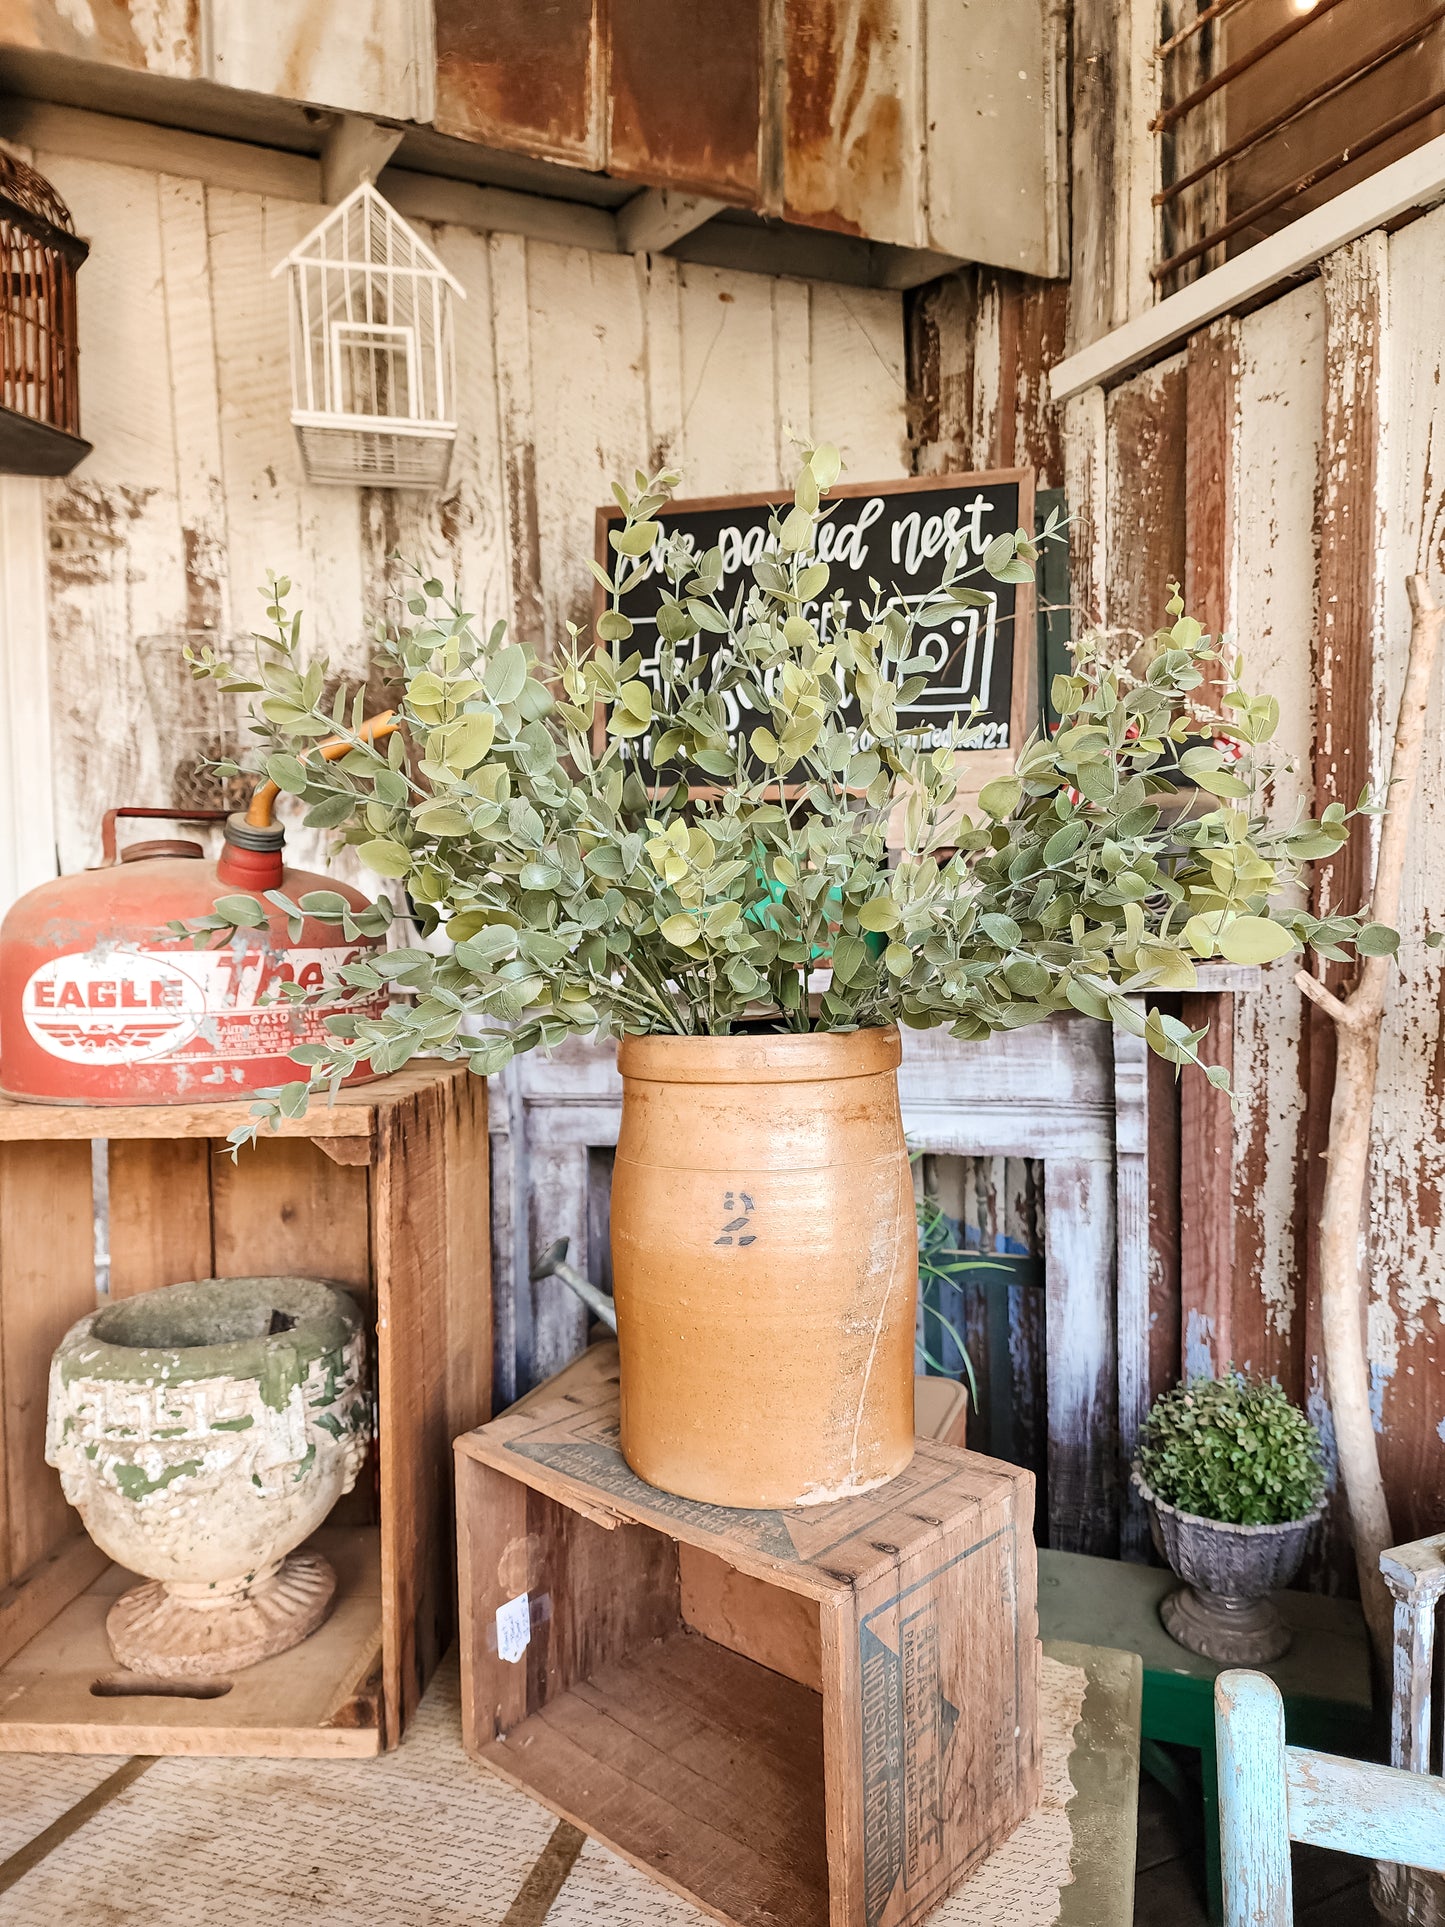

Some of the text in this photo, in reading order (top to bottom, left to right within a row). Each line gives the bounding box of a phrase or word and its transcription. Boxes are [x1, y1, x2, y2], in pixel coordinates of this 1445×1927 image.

[891, 493, 994, 575] nest
[34, 979, 183, 1009] EAGLE
[544, 1455, 624, 1490] PRODUCT
[863, 1652, 889, 1920] INDUSTRIA ARGENTINA
[888, 1660, 901, 1877] PRODUCT OF ARGENTINA
[905, 1630, 919, 1875] PARBOILED AND STEAM ROASTED
[916, 1623, 940, 1845] ROAST BEEF
